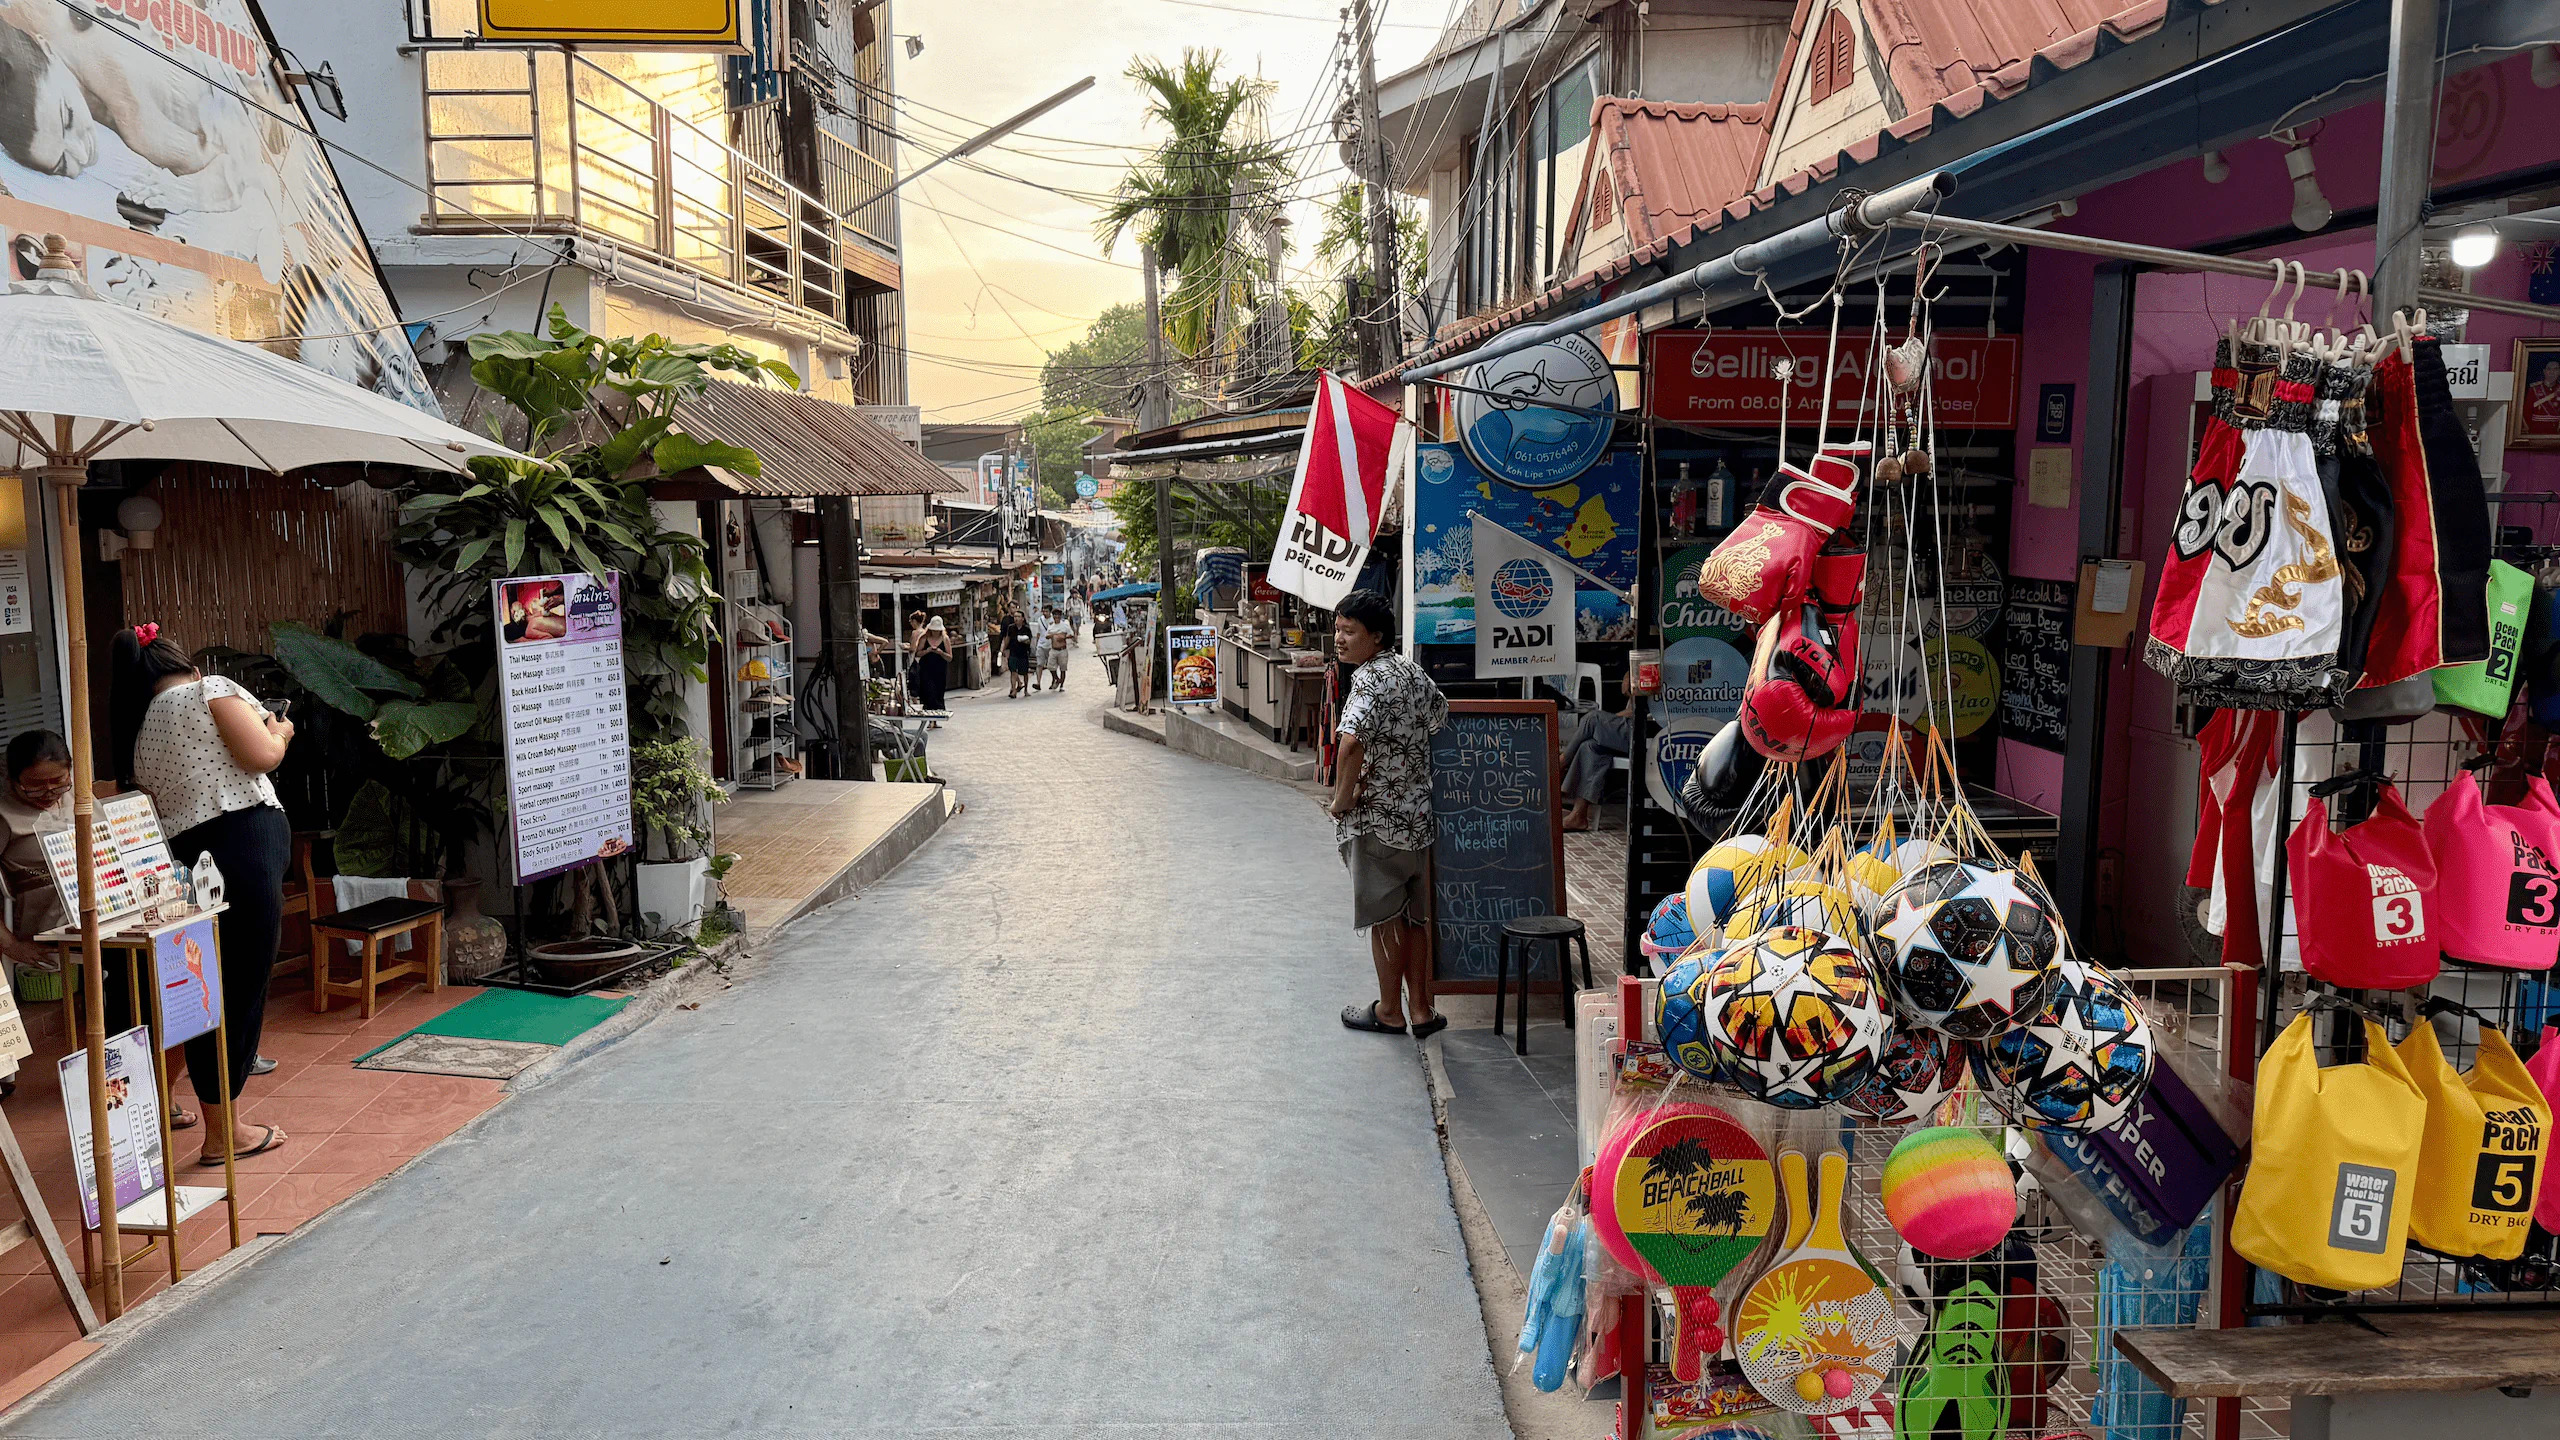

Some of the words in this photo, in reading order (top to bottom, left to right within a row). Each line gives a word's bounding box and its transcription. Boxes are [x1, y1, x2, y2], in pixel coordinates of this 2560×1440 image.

[1566, 338, 1602, 373] diving
[1688, 395, 1737, 410] From
[1740, 395, 1792, 410] 08.00
[1514, 441, 1579, 464] 061-0576449
[1506, 465, 1523, 477] Koh
[1524, 468, 1544, 480] Lipe
[1546, 455, 1583, 477] Thailand
[2010, 584, 2026, 600] Ice
[2026, 581, 2052, 603] cold
[1659, 601, 1747, 631] Chang
[2005, 606, 2032, 626] Chang
[2037, 608, 2064, 633] Beer
[1171, 637, 1216, 650] Burger
[1492, 624, 1553, 649] PADI
[509, 654, 520, 663] Thai
[520, 653, 541, 662] Massage
[1491, 656, 1529, 665] MEMBER
[1530, 653, 1556, 664] Active!
[2004, 647, 2027, 668] Leo
[2033, 653, 2060, 674] Beer
[2493, 653, 2509, 677] 2
[510, 672, 521, 680] Foot
[522, 669, 543, 678] Massage
[2484, 676, 2498, 685] DRY
[511, 688, 523, 696] Back
[524, 685, 537, 694] Head
[542, 682, 563, 691] Shoulder
[512, 704, 520, 712] Oil
[520, 702, 541, 711] Massage
[2037, 693, 2061, 717] Beer
[513, 719, 533, 729] Coconut
[534, 717, 542, 725] Oil
[542, 715, 562, 723] Massage
[1488, 717, 1542, 733] NEVER
[515, 737, 526, 745] Aloe
[526, 735, 537, 743] vere
[538, 731, 559, 740] Massage
[1456, 731, 1513, 754] DIVING
[515, 753, 526, 761] Milk
[527, 750, 542, 759] Cream
[543, 747, 555, 756] Body
[556, 744, 576, 752] Massage
[1432, 748, 1532, 769] BEFORE
[534, 764, 555, 774] massage
[518, 784, 531, 794] Sport
[532, 781, 553, 790] massage
[519, 799, 536, 810] Herbal
[536, 795, 559, 806] compress
[560, 790, 580, 800] massage
[1443, 791, 1471, 806] WITH
[520, 817, 531, 826] Foot
[532, 813, 546, 823] Scrub
[1435, 815, 1455, 836] No
[1457, 813, 1529, 841] Certification
[521, 832, 537, 842] Aroma
[538, 829, 546, 837] Oil
[546, 825, 566, 835] Massage
[522, 849, 534, 858] Body
[535, 845, 549, 854] Scrup
[554, 840, 562, 849] Oil
[562, 836, 582, 846] Massage
[1454, 833, 1508, 854] Needed
[1448, 896, 1547, 922] CERTIFIED
[2521, 877, 2558, 924] 3
[2385, 897, 2414, 935] 3
[1437, 922, 1497, 944] DIVER
[2504, 924, 2532, 933] DRY
[2540, 928, 2558, 936] BAG
[2376, 937, 2402, 948] DRY
[2406, 934, 2427, 944] BAG
[2, 1037, 16, 1048] 450
[1642, 1167, 1745, 1208] BEACHBALL
[2346, 1173, 2389, 1193] Water
[2491, 1162, 2524, 1207] 5
[2344, 1186, 2368, 1200] Proof
[2367, 1190, 2385, 1203] bag
[2350, 1203, 2373, 1236] 5
[2468, 1212, 2502, 1227] DRY
[1763, 1349, 1801, 1361] Ball
[1814, 1353, 1862, 1366] Beach
